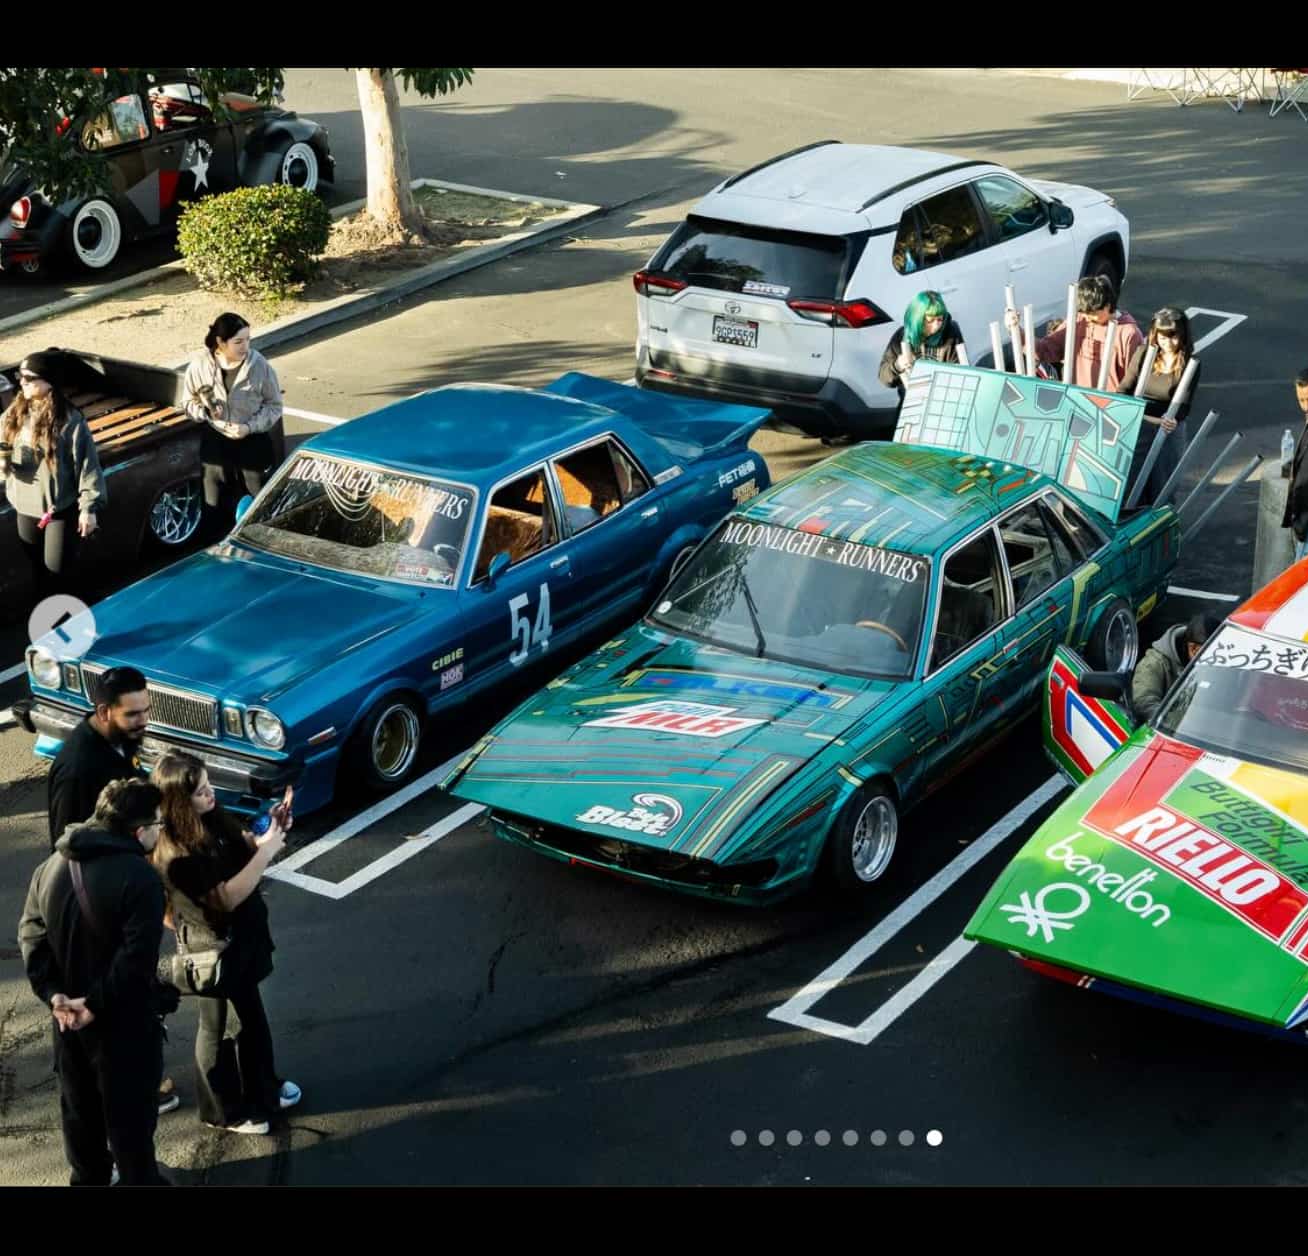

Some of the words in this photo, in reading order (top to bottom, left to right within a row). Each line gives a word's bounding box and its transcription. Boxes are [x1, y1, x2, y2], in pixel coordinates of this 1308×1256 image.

[288, 457, 382, 493] MOONLIGHT
[391, 478, 469, 520] RUNNERS
[719, 522, 828, 557] MOONLIGHT
[837, 542, 924, 583] RUNNERS
[432, 648, 464, 671] CIBIE
[508, 582, 552, 667] 54
[1045, 832, 1171, 928] benetton
[1114, 807, 1281, 906] RIELLO
